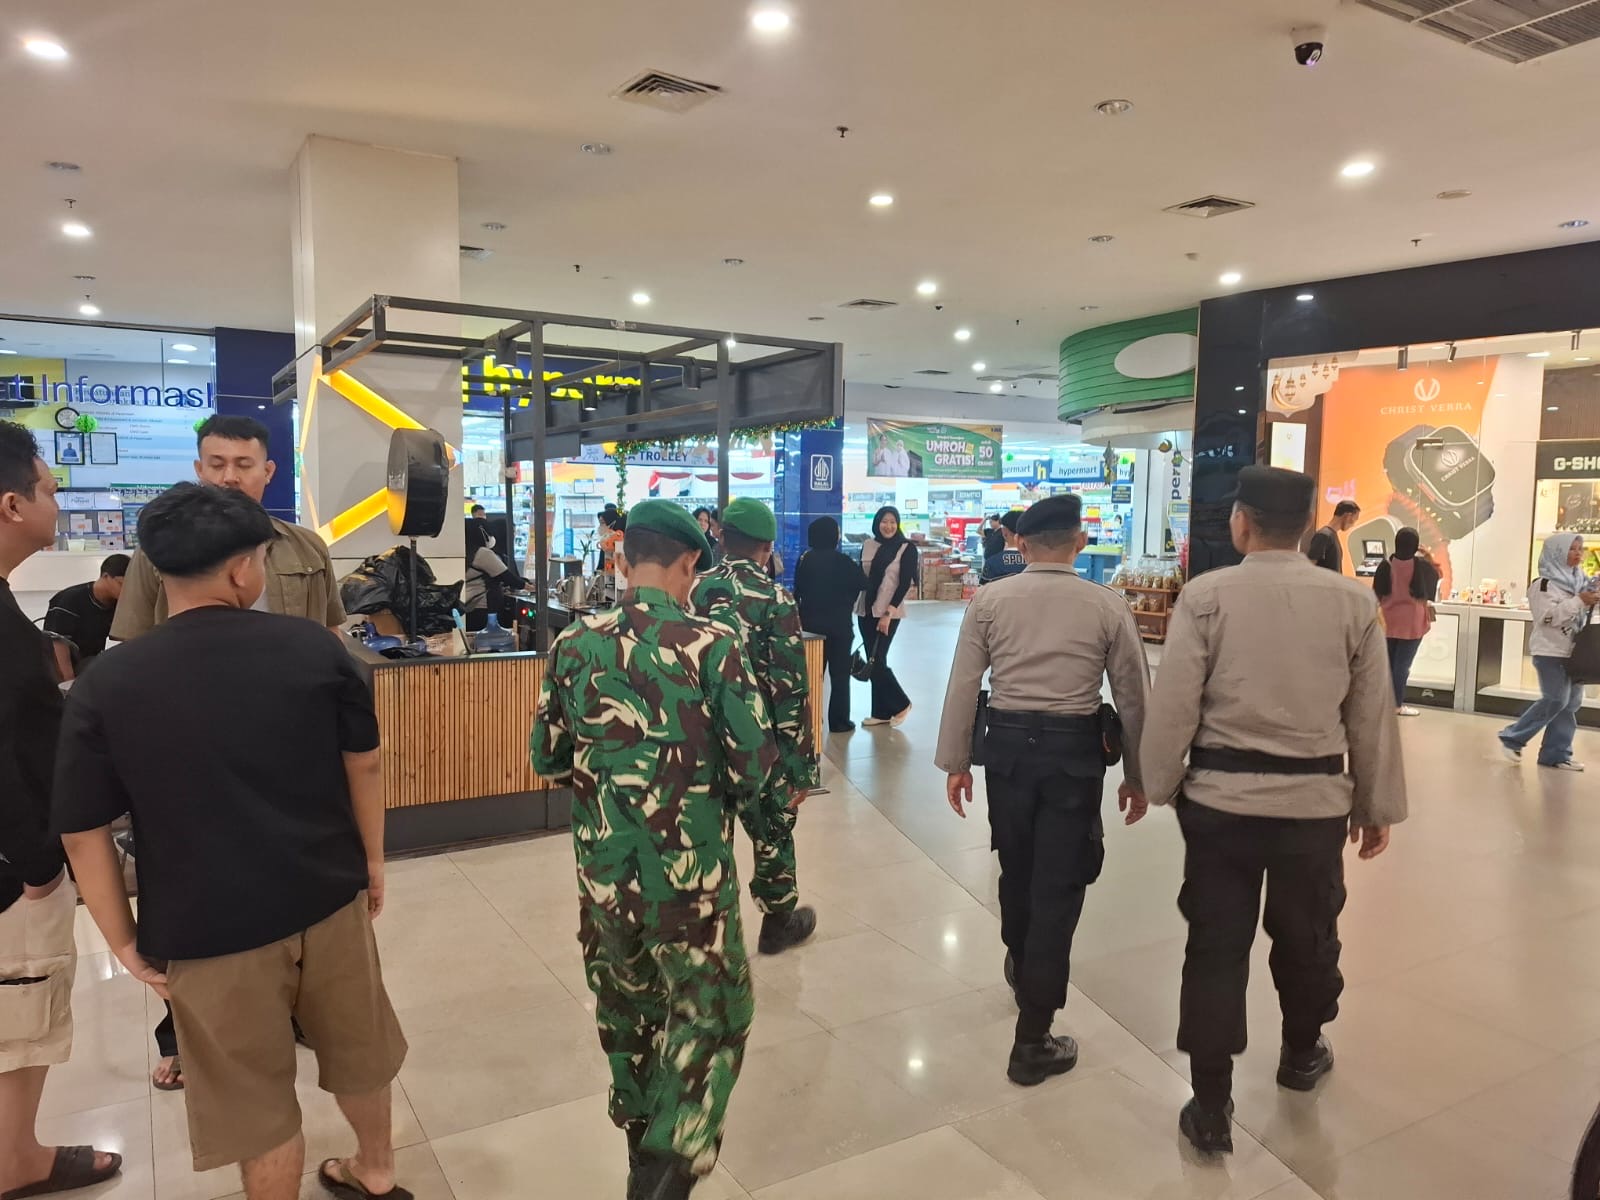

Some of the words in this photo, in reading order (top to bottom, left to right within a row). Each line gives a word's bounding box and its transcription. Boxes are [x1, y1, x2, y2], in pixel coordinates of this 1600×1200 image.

[1380, 404, 1425, 415] CHRIST
[1430, 402, 1472, 412] VERRA
[926, 440, 966, 453] UMROH
[979, 446, 993, 458] 50
[935, 453, 975, 466] GRATIS!
[1553, 456, 1600, 471] G-SH
[1058, 466, 1097, 476] hypermart
[1002, 553, 1026, 565] SPO
